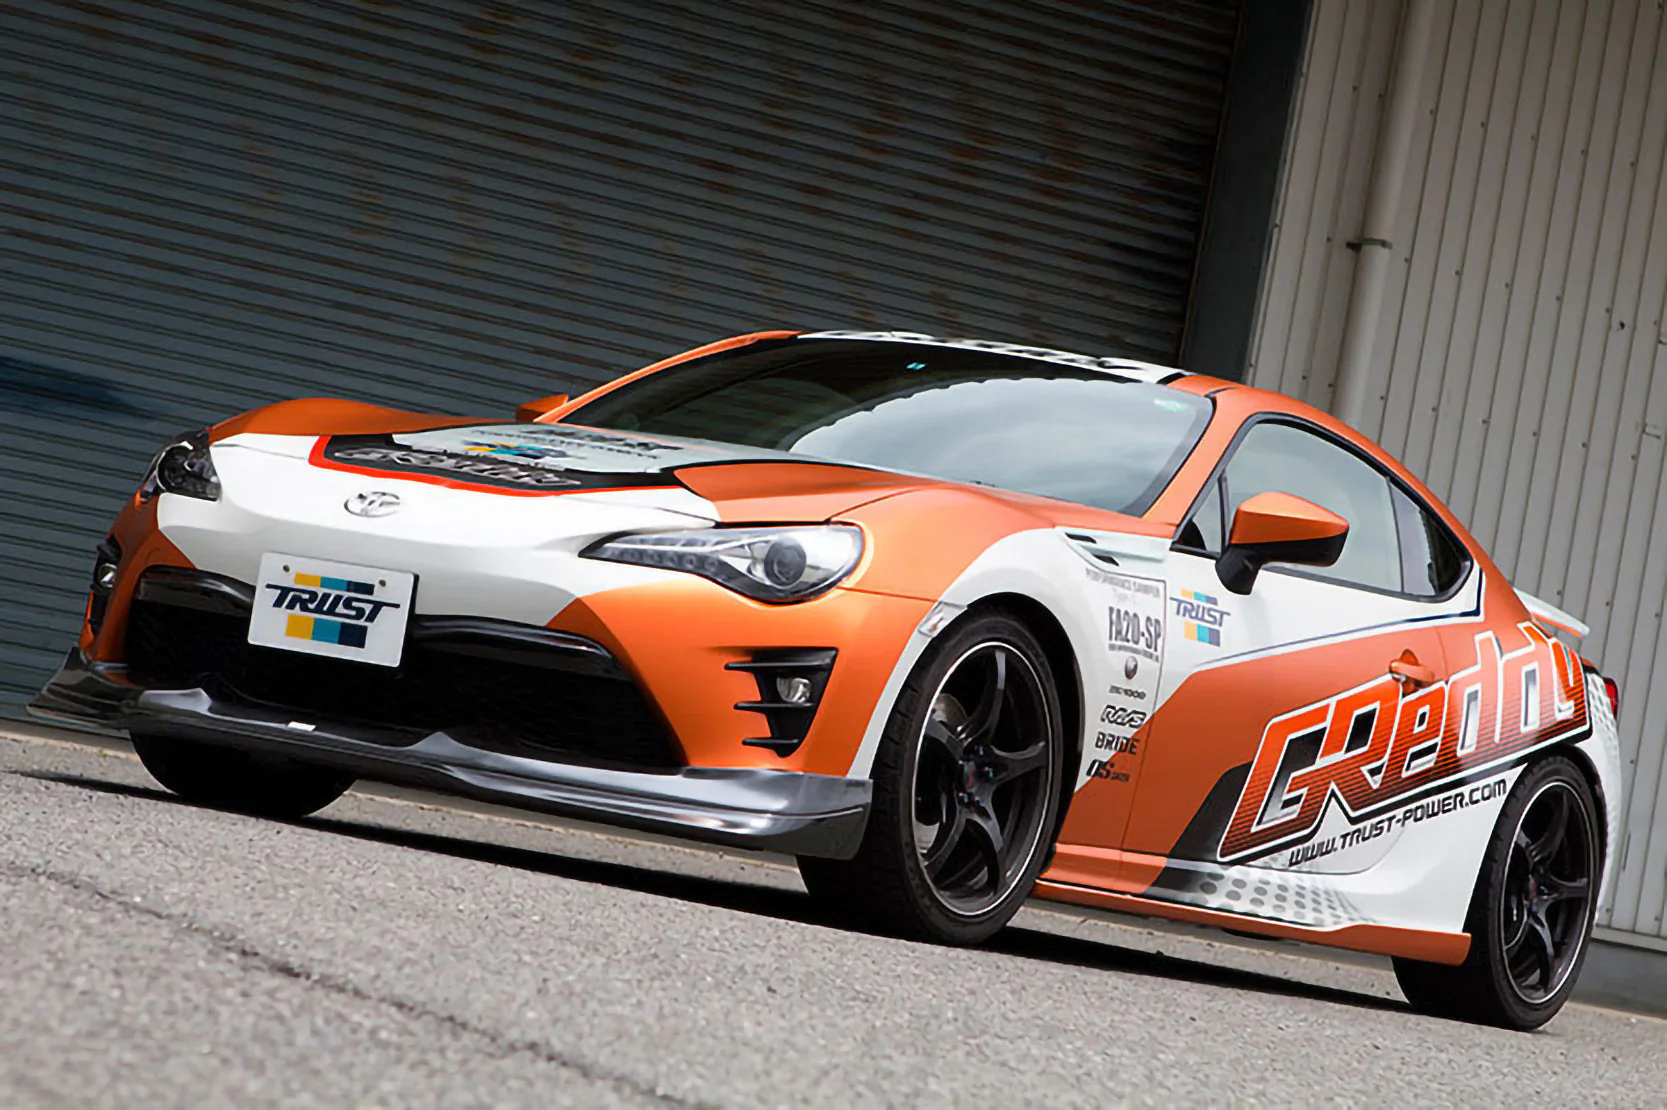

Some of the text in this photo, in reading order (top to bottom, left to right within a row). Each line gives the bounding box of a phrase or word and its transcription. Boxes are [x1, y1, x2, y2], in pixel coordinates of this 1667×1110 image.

[265, 583, 400, 623] TRUST
[1169, 597, 1231, 627] TRUST
[1108, 606, 1161, 652] FA20-SP
[1095, 731, 1141, 755] BRIDE
